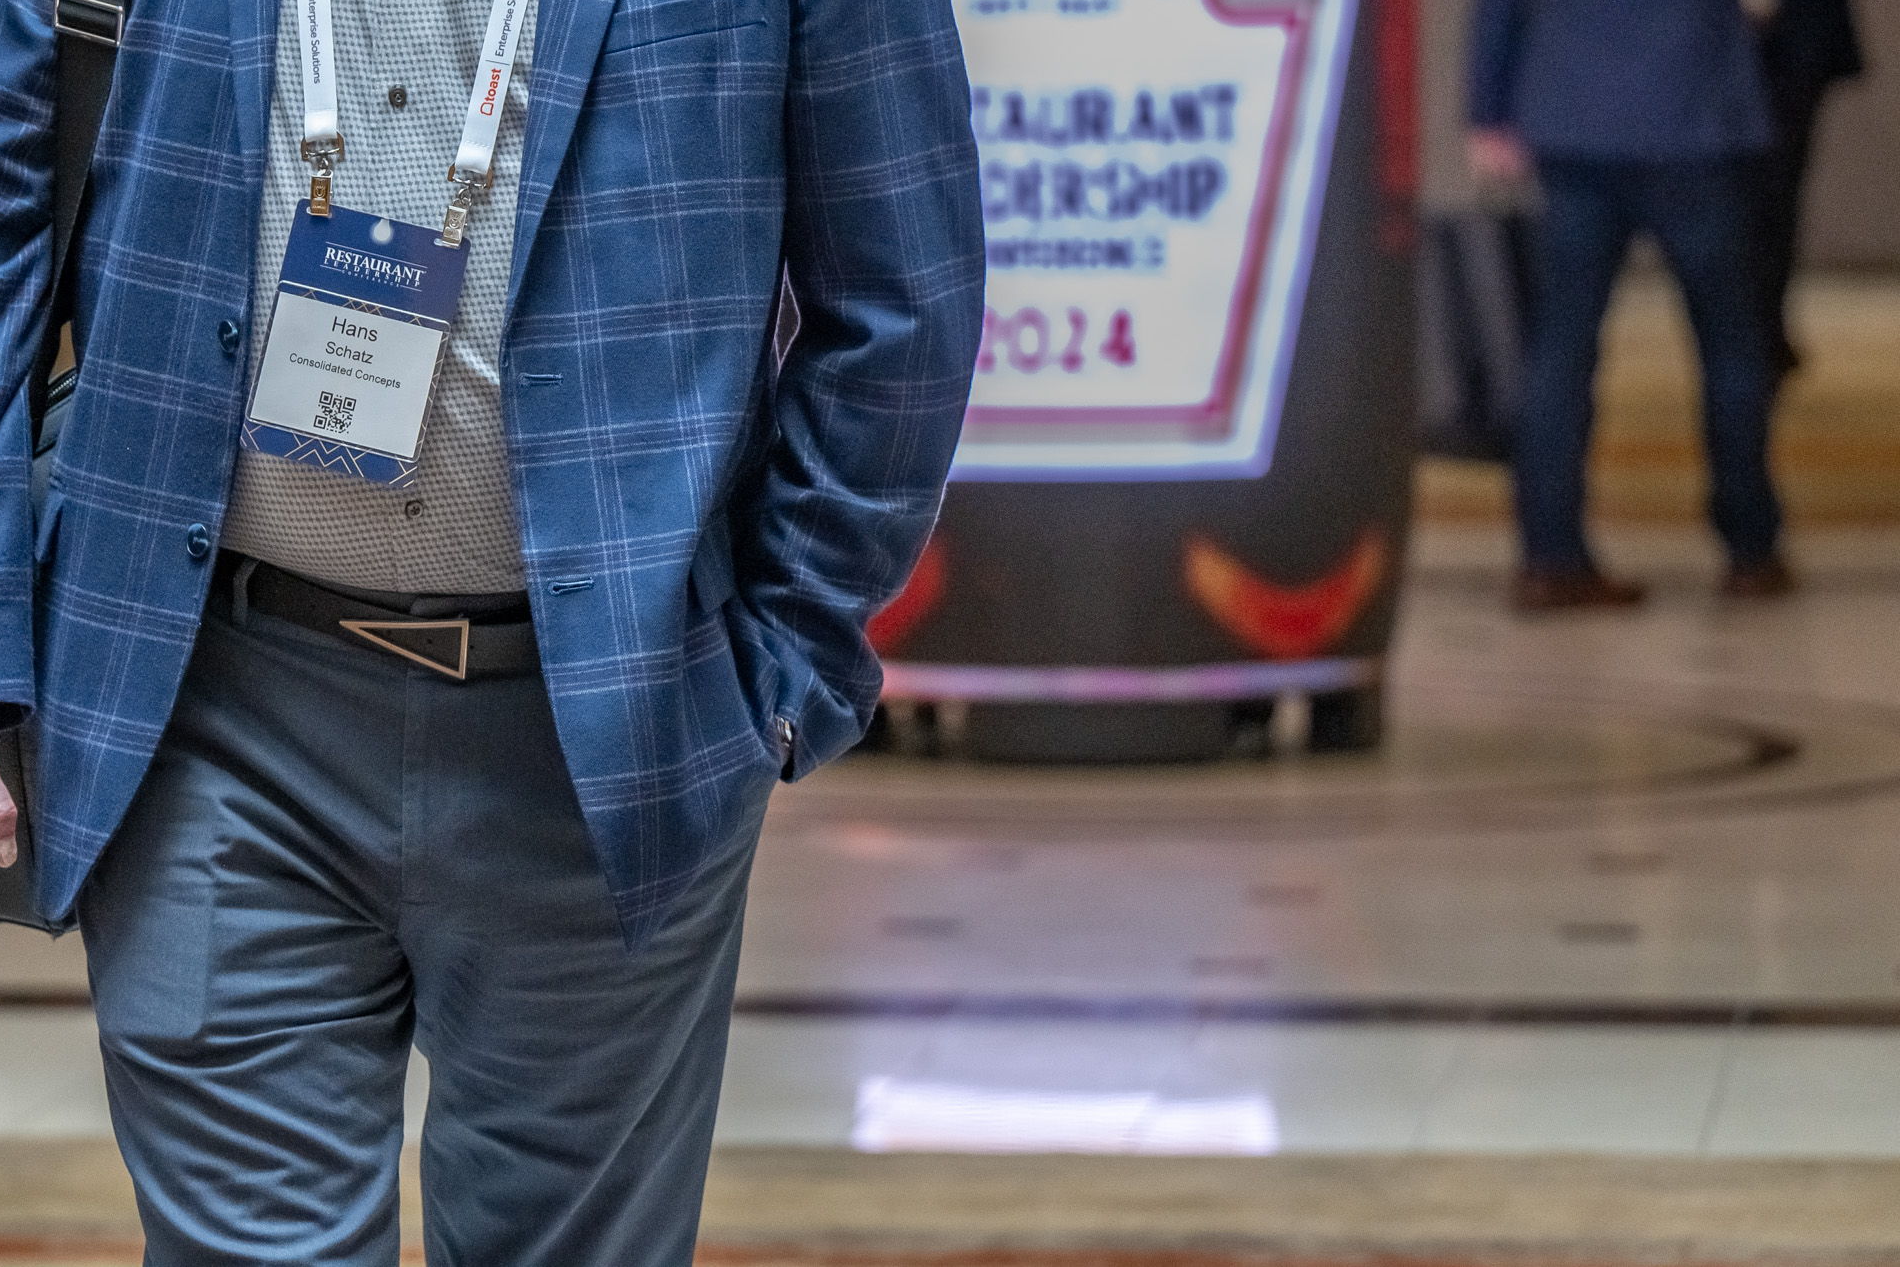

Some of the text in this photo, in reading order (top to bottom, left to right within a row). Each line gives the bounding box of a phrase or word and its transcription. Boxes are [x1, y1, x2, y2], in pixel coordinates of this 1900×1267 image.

[311, 39, 320, 84] Solutions
[484, 68, 502, 102] toast
[495, 8, 514, 57] Enterprise
[324, 258, 420, 287] LEADERSHIP
[325, 247, 424, 281] RESTAURANT
[331, 316, 378, 342] Hans
[325, 341, 374, 364] Schatz
[289, 353, 401, 389] Consolidated Concepts
